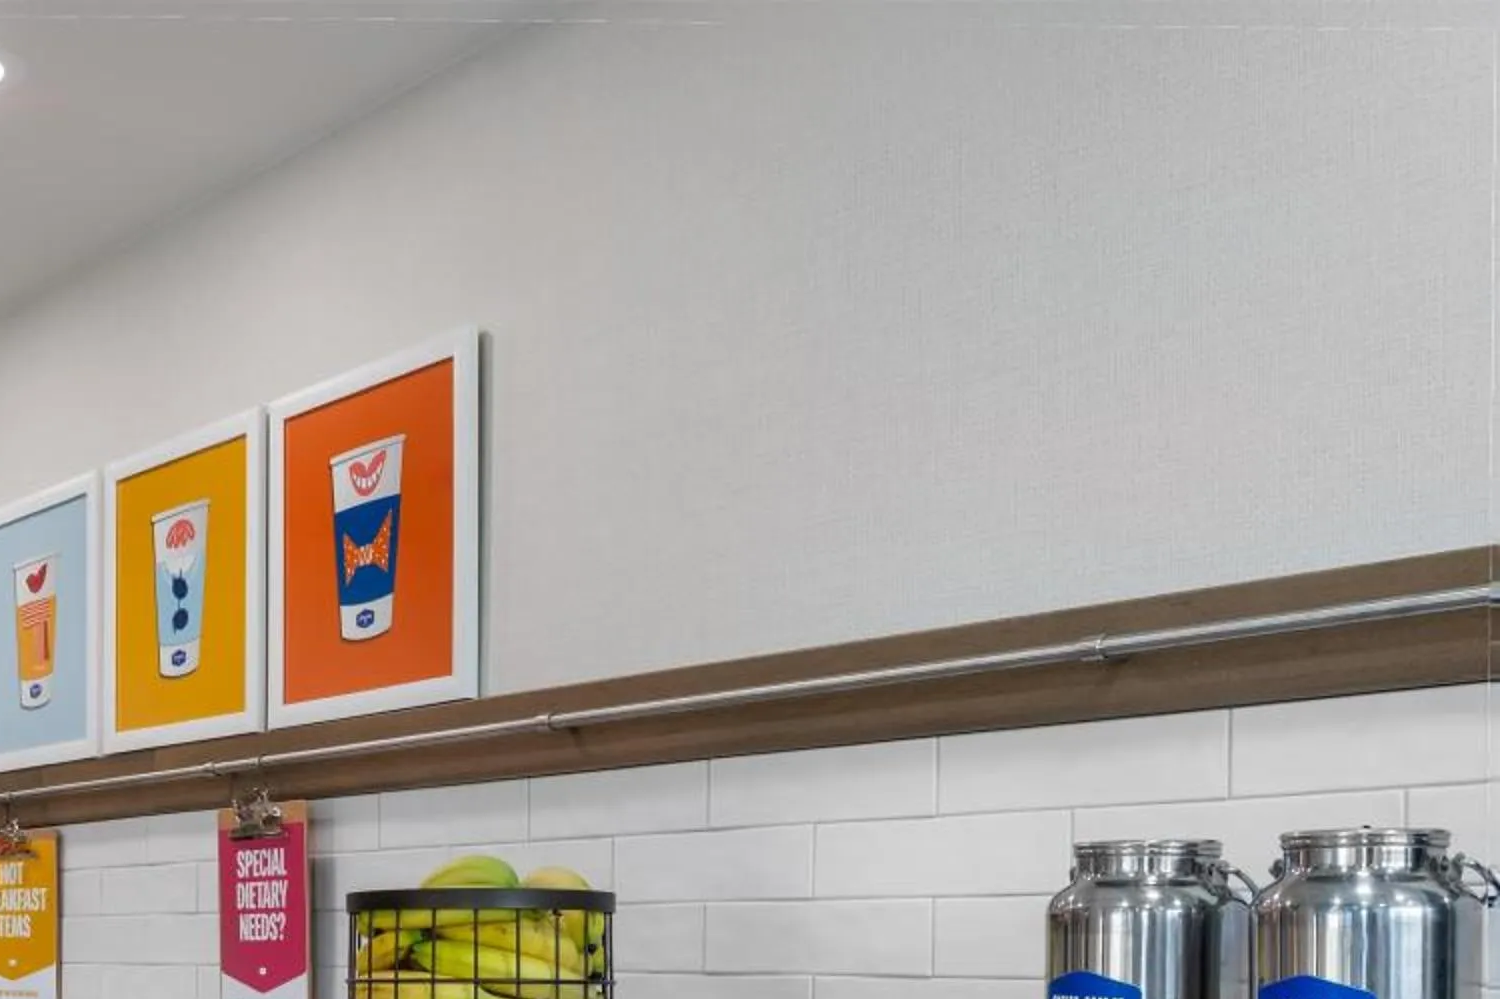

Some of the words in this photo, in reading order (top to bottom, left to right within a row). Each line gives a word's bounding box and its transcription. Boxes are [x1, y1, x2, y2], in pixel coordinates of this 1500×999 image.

[0, 861, 25, 885] HOT
[236, 848, 287, 879] SPECIAL
[236, 879, 288, 910] DIETARY
[239, 911, 286, 942] NEEDS?
